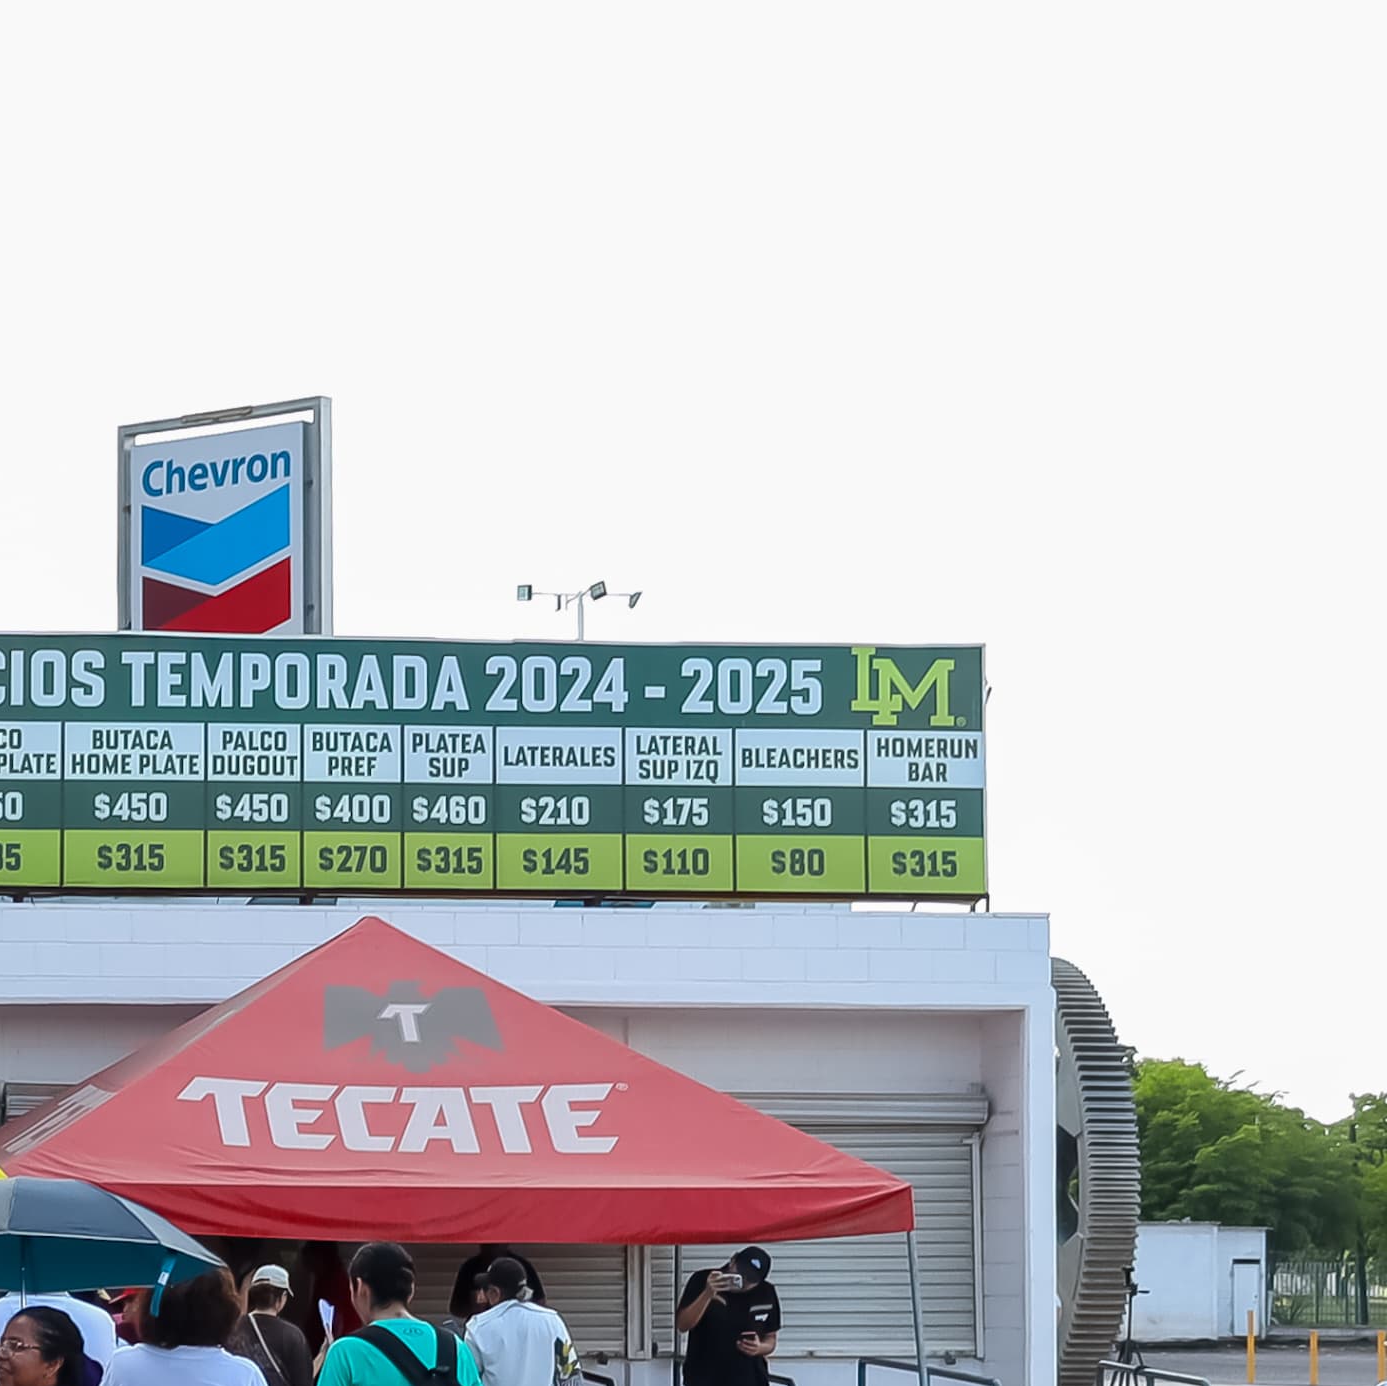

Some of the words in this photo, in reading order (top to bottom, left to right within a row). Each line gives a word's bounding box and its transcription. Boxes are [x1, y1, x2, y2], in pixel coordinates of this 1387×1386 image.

[142, 449, 291, 497] Chevron
[121, 651, 470, 711] TEMPORADA
[485, 654, 628, 714] 2024
[680, 657, 822, 716] 2025
[92, 729, 173, 751] BUTACA
[222, 730, 287, 752] PALCO
[312, 731, 393, 753] BUTACA
[412, 732, 486, 754] PLATEA
[635, 734, 723, 757] LATERAL
[876, 736, 979, 760] HOMERUN
[71, 754, 134, 775] HOME
[138, 754, 199, 776] PLATE
[212, 755, 298, 776] DUGOUT
[327, 756, 377, 777] PREF
[503, 744, 616, 768] LATERALES
[741, 746, 859, 771] BLEACHERS
[429, 758, 470, 778] SUP
[638, 759, 679, 780] SUP
[685, 760, 720, 784] IZQ
[907, 761, 948, 783] BAR
[94, 792, 168, 823] $450
[215, 793, 289, 823] $450
[314, 794, 392, 824] $400
[412, 795, 487, 825] $460
[520, 796, 590, 826] $210
[643, 797, 709, 827] $175
[762, 798, 832, 828] $150
[890, 799, 958, 830] $315
[97, 843, 165, 873] $315
[219, 844, 286, 873] $315
[318, 845, 388, 873] $270
[416, 846, 483, 875] $315
[523, 846, 590, 876] $145
[643, 847, 710, 877] $110
[771, 848, 825, 877] $80
[891, 850, 958, 878] $315
[378, 1002, 433, 1043] T
[175, 1075, 620, 1155] TECATE
